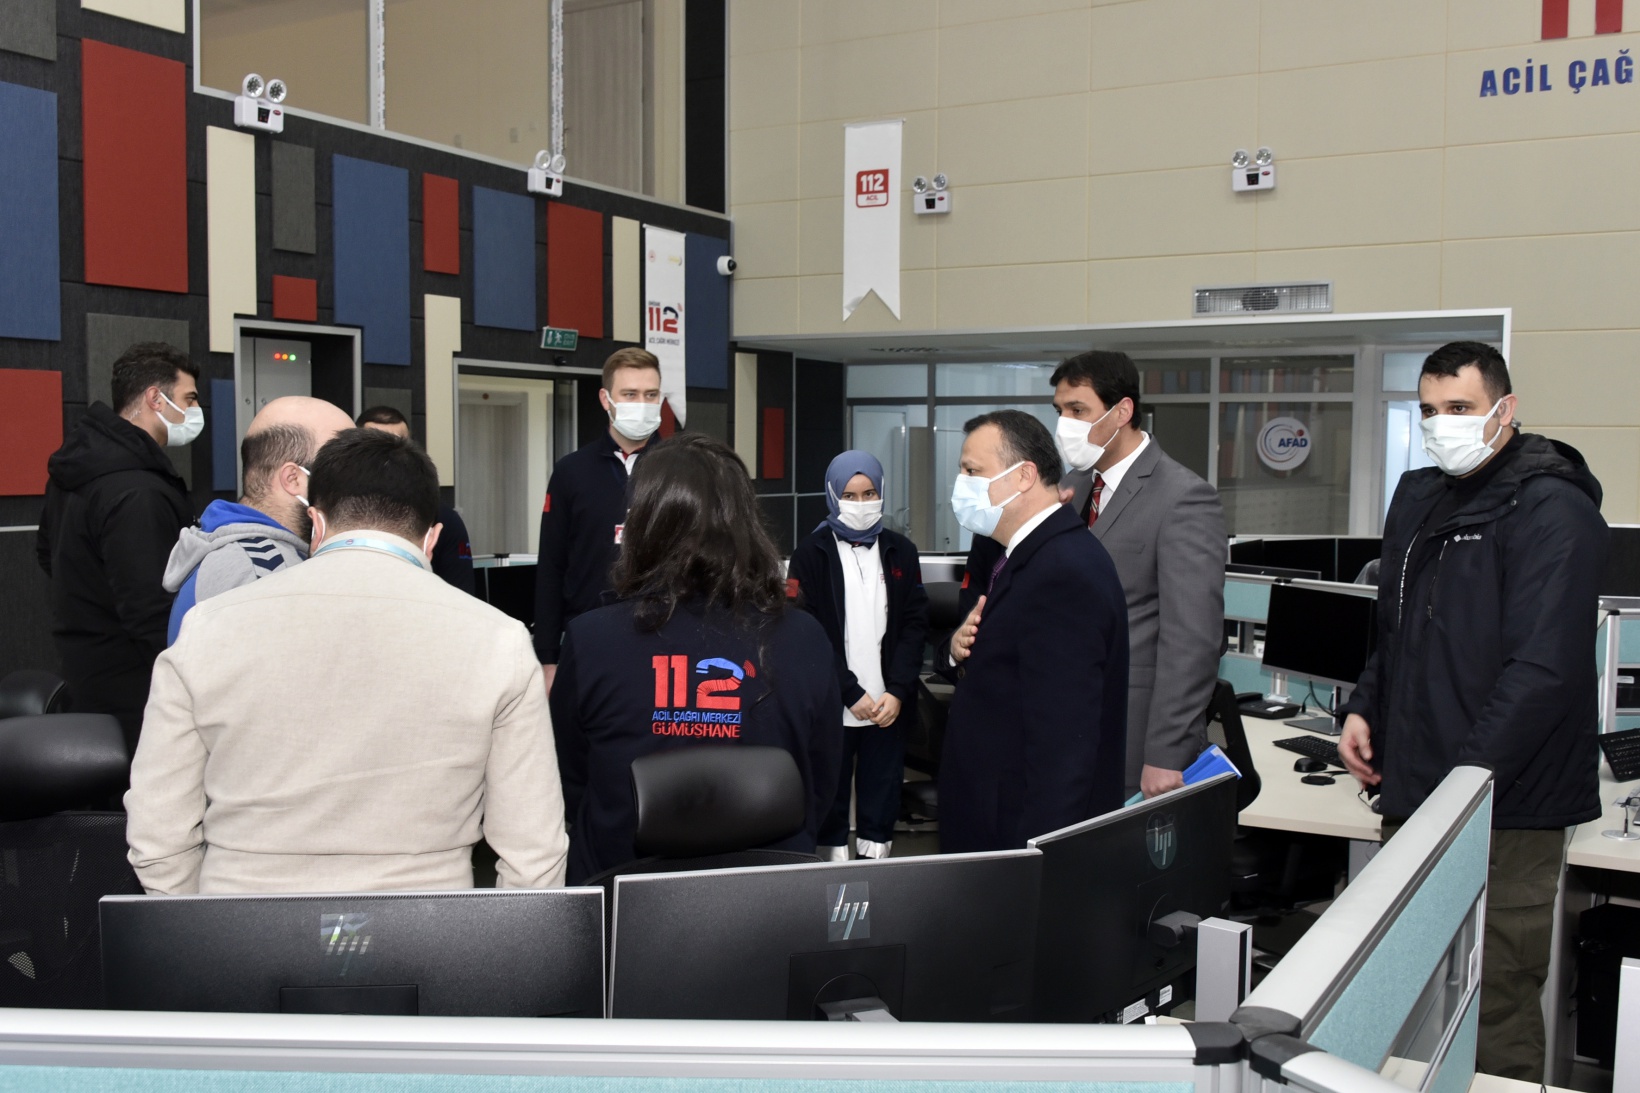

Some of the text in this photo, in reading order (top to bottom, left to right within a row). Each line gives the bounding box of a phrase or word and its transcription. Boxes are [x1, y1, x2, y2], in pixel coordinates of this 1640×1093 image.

[1479, 58, 1552, 98] ACİL
[860, 173, 884, 193] 112
[648, 306, 679, 334] 112
[1278, 437, 1308, 448] AFAD
[652, 655, 744, 710] 112
[652, 710, 742, 724] ACİL ÇAĞRI MERKEZİ
[652, 722, 741, 738] GÜMÜŞHANE
[830, 883, 869, 940] hp
